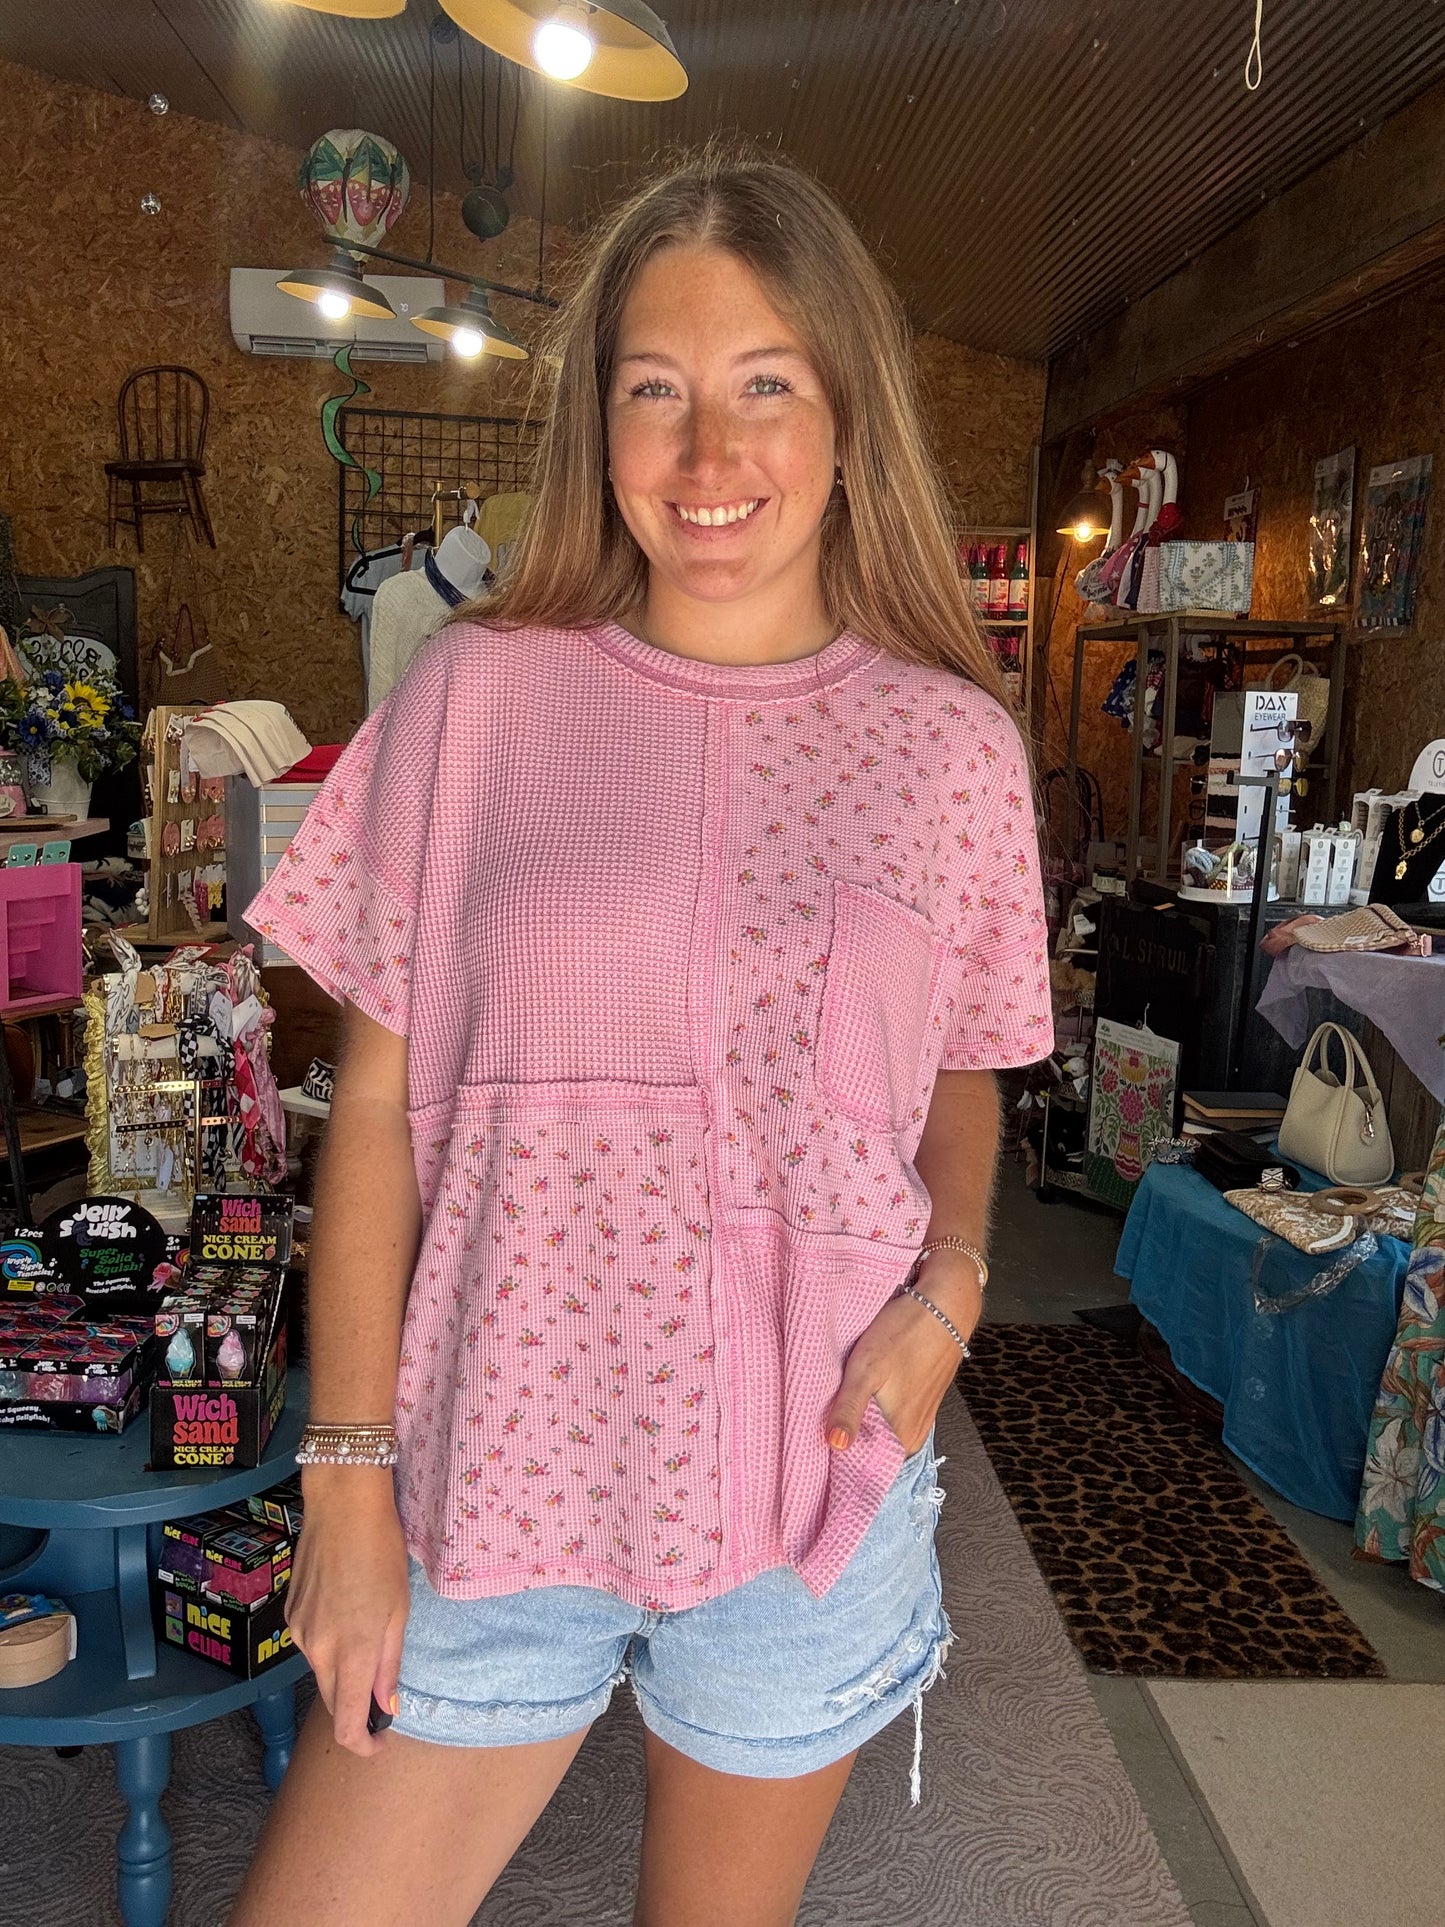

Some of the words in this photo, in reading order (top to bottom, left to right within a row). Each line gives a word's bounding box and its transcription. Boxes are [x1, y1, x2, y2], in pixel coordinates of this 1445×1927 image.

[1255, 695, 1287, 711] DAX
[1254, 712, 1287, 721] EYEWEAR
[221, 1198, 262, 1217] Wich
[219, 1215, 262, 1233] sand
[166, 1236, 181, 1246] 3+
[203, 1234, 231, 1244] NICE
[234, 1235, 277, 1245] CREAM
[79, 1248, 118, 1259] Super
[99, 1252, 134, 1265] Solid
[202, 1244, 264, 1260] CONE
[93, 1262, 143, 1277] Squish!
[172, 1393, 238, 1421] Wich
[173, 1417, 239, 1444] sand
[173, 1453, 225, 1465] CONE
[187, 1630, 232, 1666] CUBE
